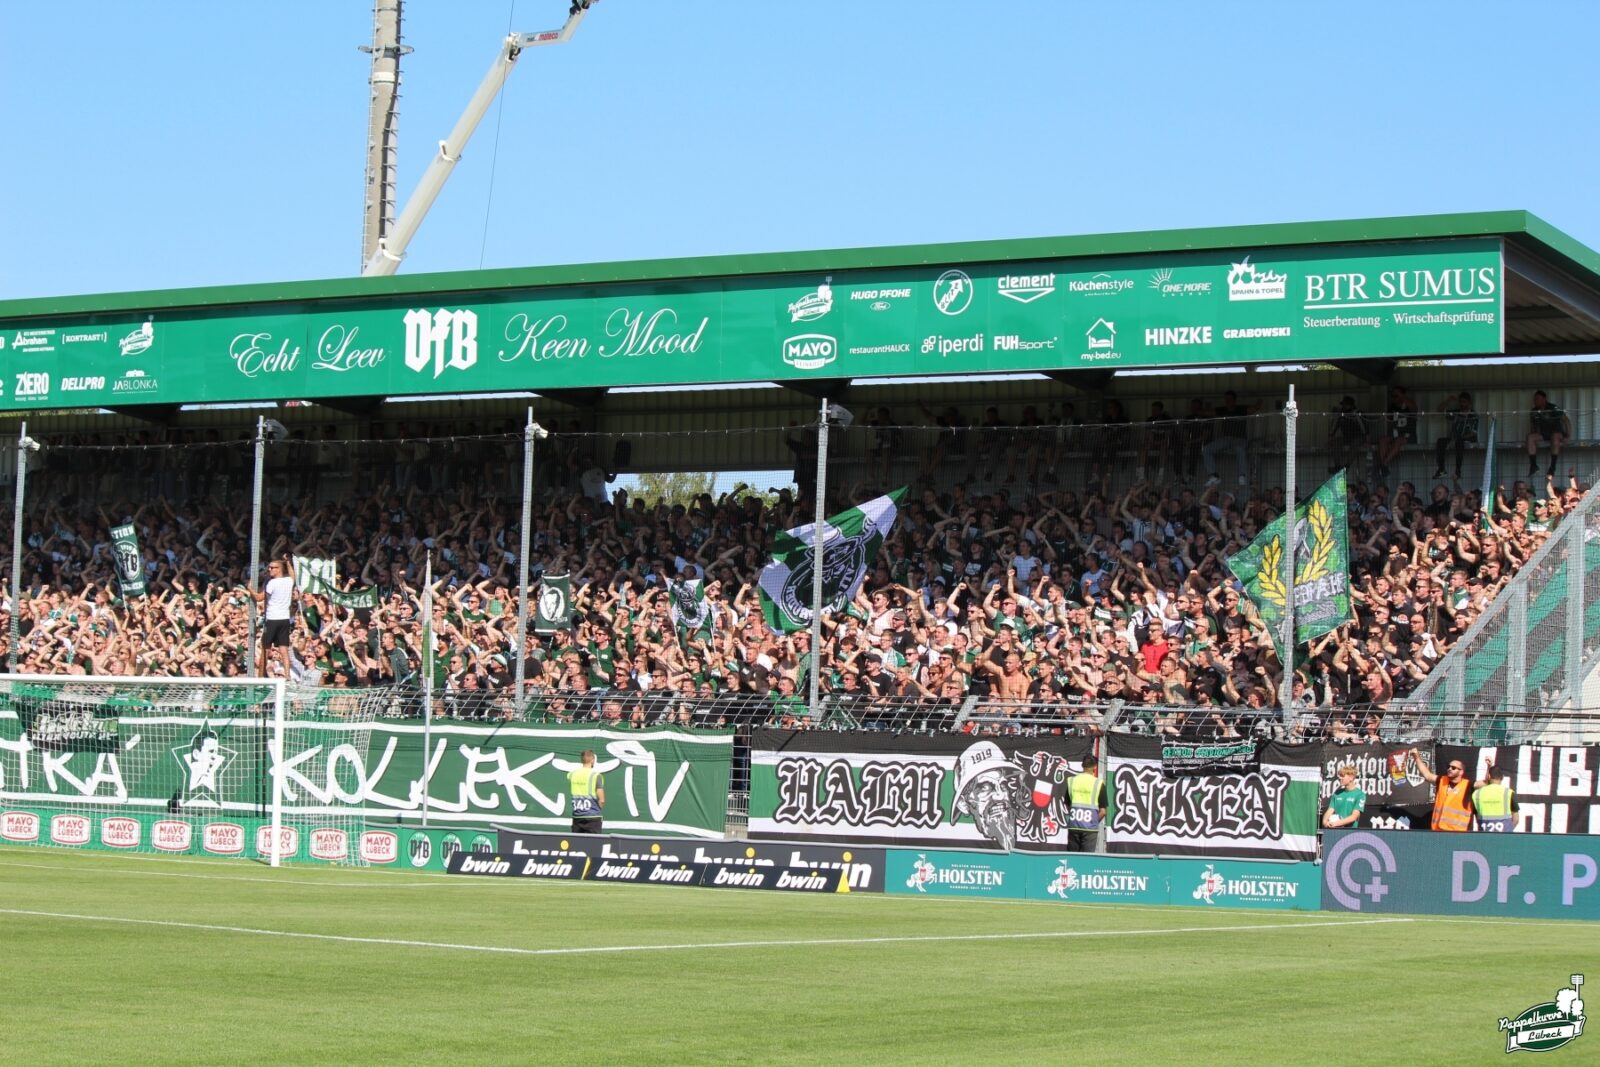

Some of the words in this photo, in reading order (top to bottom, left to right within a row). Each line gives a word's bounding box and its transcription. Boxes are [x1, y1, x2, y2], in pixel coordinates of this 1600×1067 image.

[998, 273, 1056, 288] clement
[1305, 274, 1369, 300] BTR
[1379, 268, 1495, 298] SUMUS
[851, 290, 878, 300] HUGO
[879, 288, 912, 299] PFOHE
[1304, 316, 1380, 327] Steuerberatung
[1393, 311, 1494, 326] Wirtschaftsprüfung
[498, 313, 592, 362] Keen
[599, 307, 710, 358] Mood
[1145, 326, 1212, 346] HINZKE
[1223, 327, 1291, 339] GRABOWSKI
[230, 333, 301, 377] Echt
[312, 324, 386, 371] Leev
[788, 342, 832, 357] MAYO
[938, 334, 984, 357] iperdi
[61, 376, 106, 391] DELLPRO
[112, 379, 158, 391] JABLONKA
[971, 749, 992, 765] 1919
[1474, 745, 1600, 796] LÜB
[572, 799, 592, 811] 340
[7, 816, 33, 826] MAYO
[1070, 808, 1092, 823] 308
[58, 820, 84, 829] MAYO
[108, 823, 135, 832] MAYO
[159, 825, 186, 835] MAYO
[210, 828, 238, 838] MAYO
[264, 831, 291, 841] MYO
[316, 834, 343, 843] MAYO
[366, 836, 391, 846] MAYO
[460, 856, 511, 873] bwin
[522, 859, 573, 876] bwin
[596, 861, 641, 879] bwin
[649, 864, 694, 882] bwin
[714, 867, 765, 887] bwin
[775, 871, 828, 889] bwin
[939, 868, 1004, 886] HOLSTEN
[1452, 850, 1536, 905] Dr.
[1562, 853, 1598, 906] P
[1081, 874, 1148, 891] HOLSTEN
[1228, 879, 1297, 897] HOLSTEN
